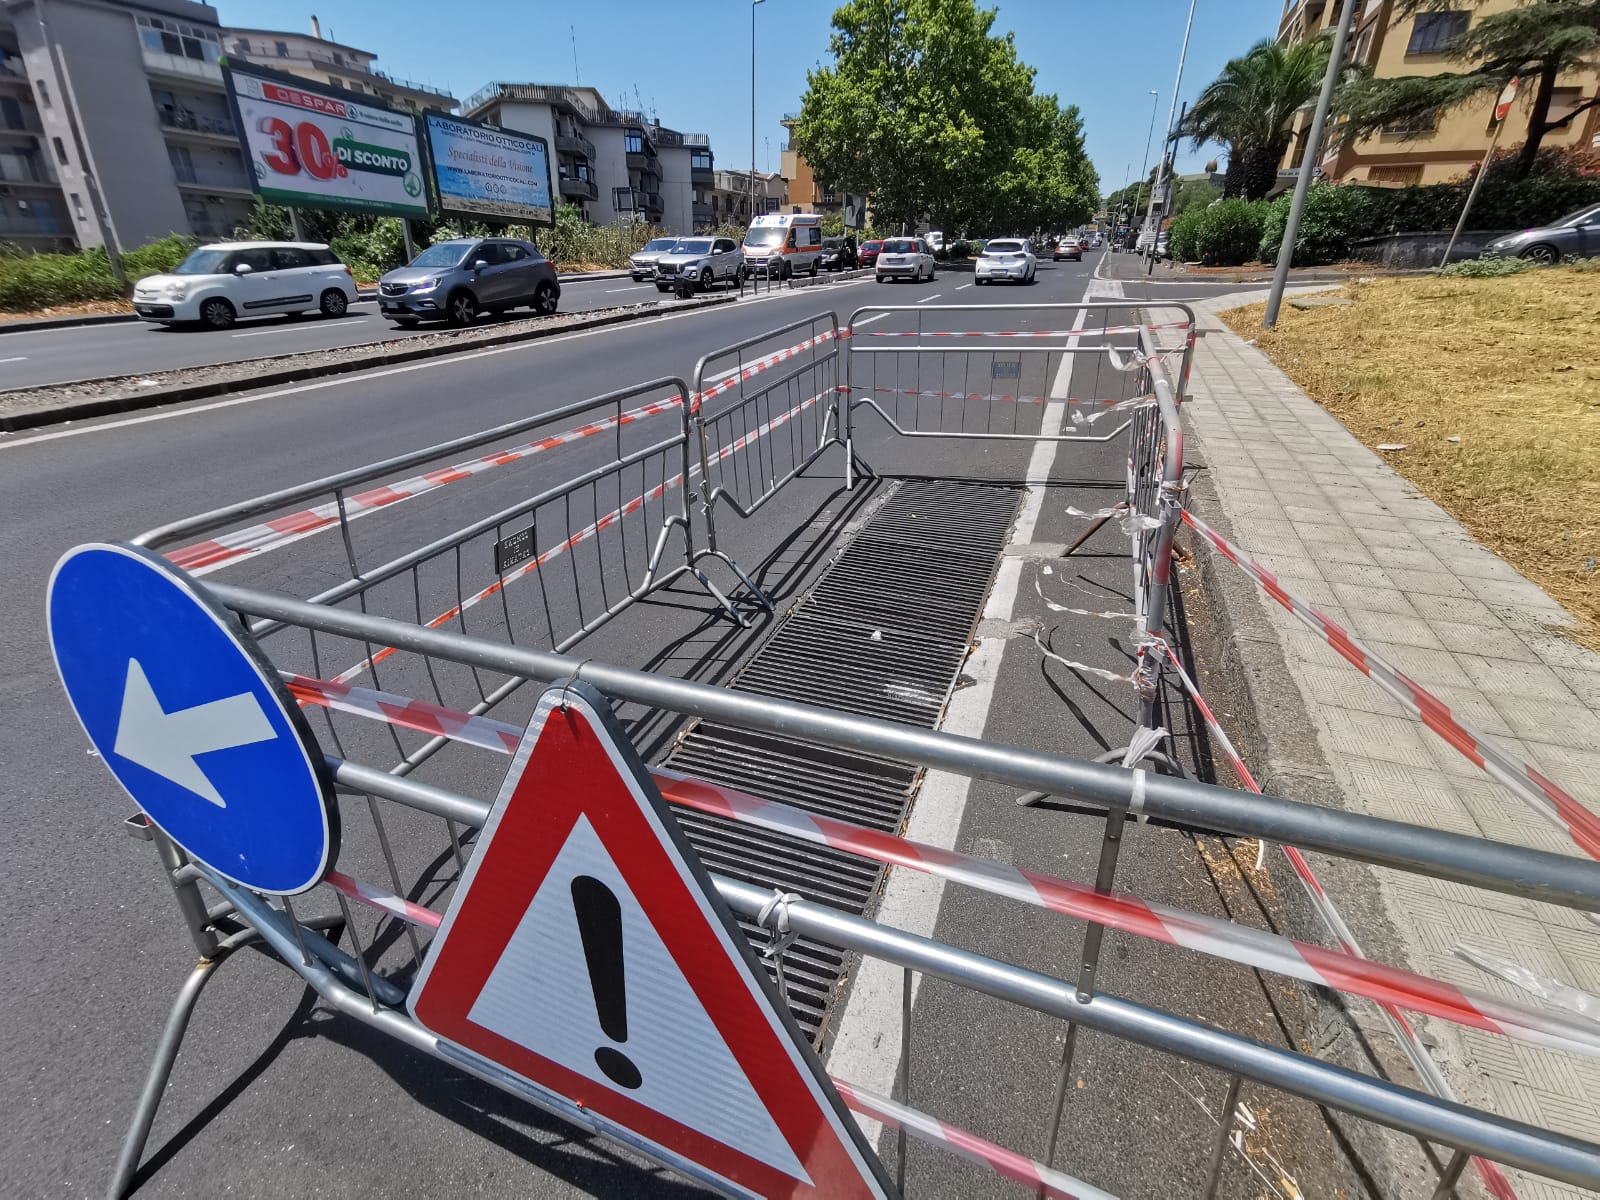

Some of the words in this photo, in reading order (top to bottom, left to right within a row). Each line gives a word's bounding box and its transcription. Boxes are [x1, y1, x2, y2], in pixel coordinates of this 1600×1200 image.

[277, 90, 346, 115] DESPAR
[257, 116, 348, 181] 30%
[336, 146, 352, 161] DI
[352, 150, 408, 171] SCONTO
[428, 119, 495, 143] LABORATORIO
[496, 136, 525, 149] OTTICO
[526, 141, 543, 152] CALI
[447, 146, 489, 166] Specialisti
[489, 155, 507, 168] della
[508, 159, 533, 174] Visione
